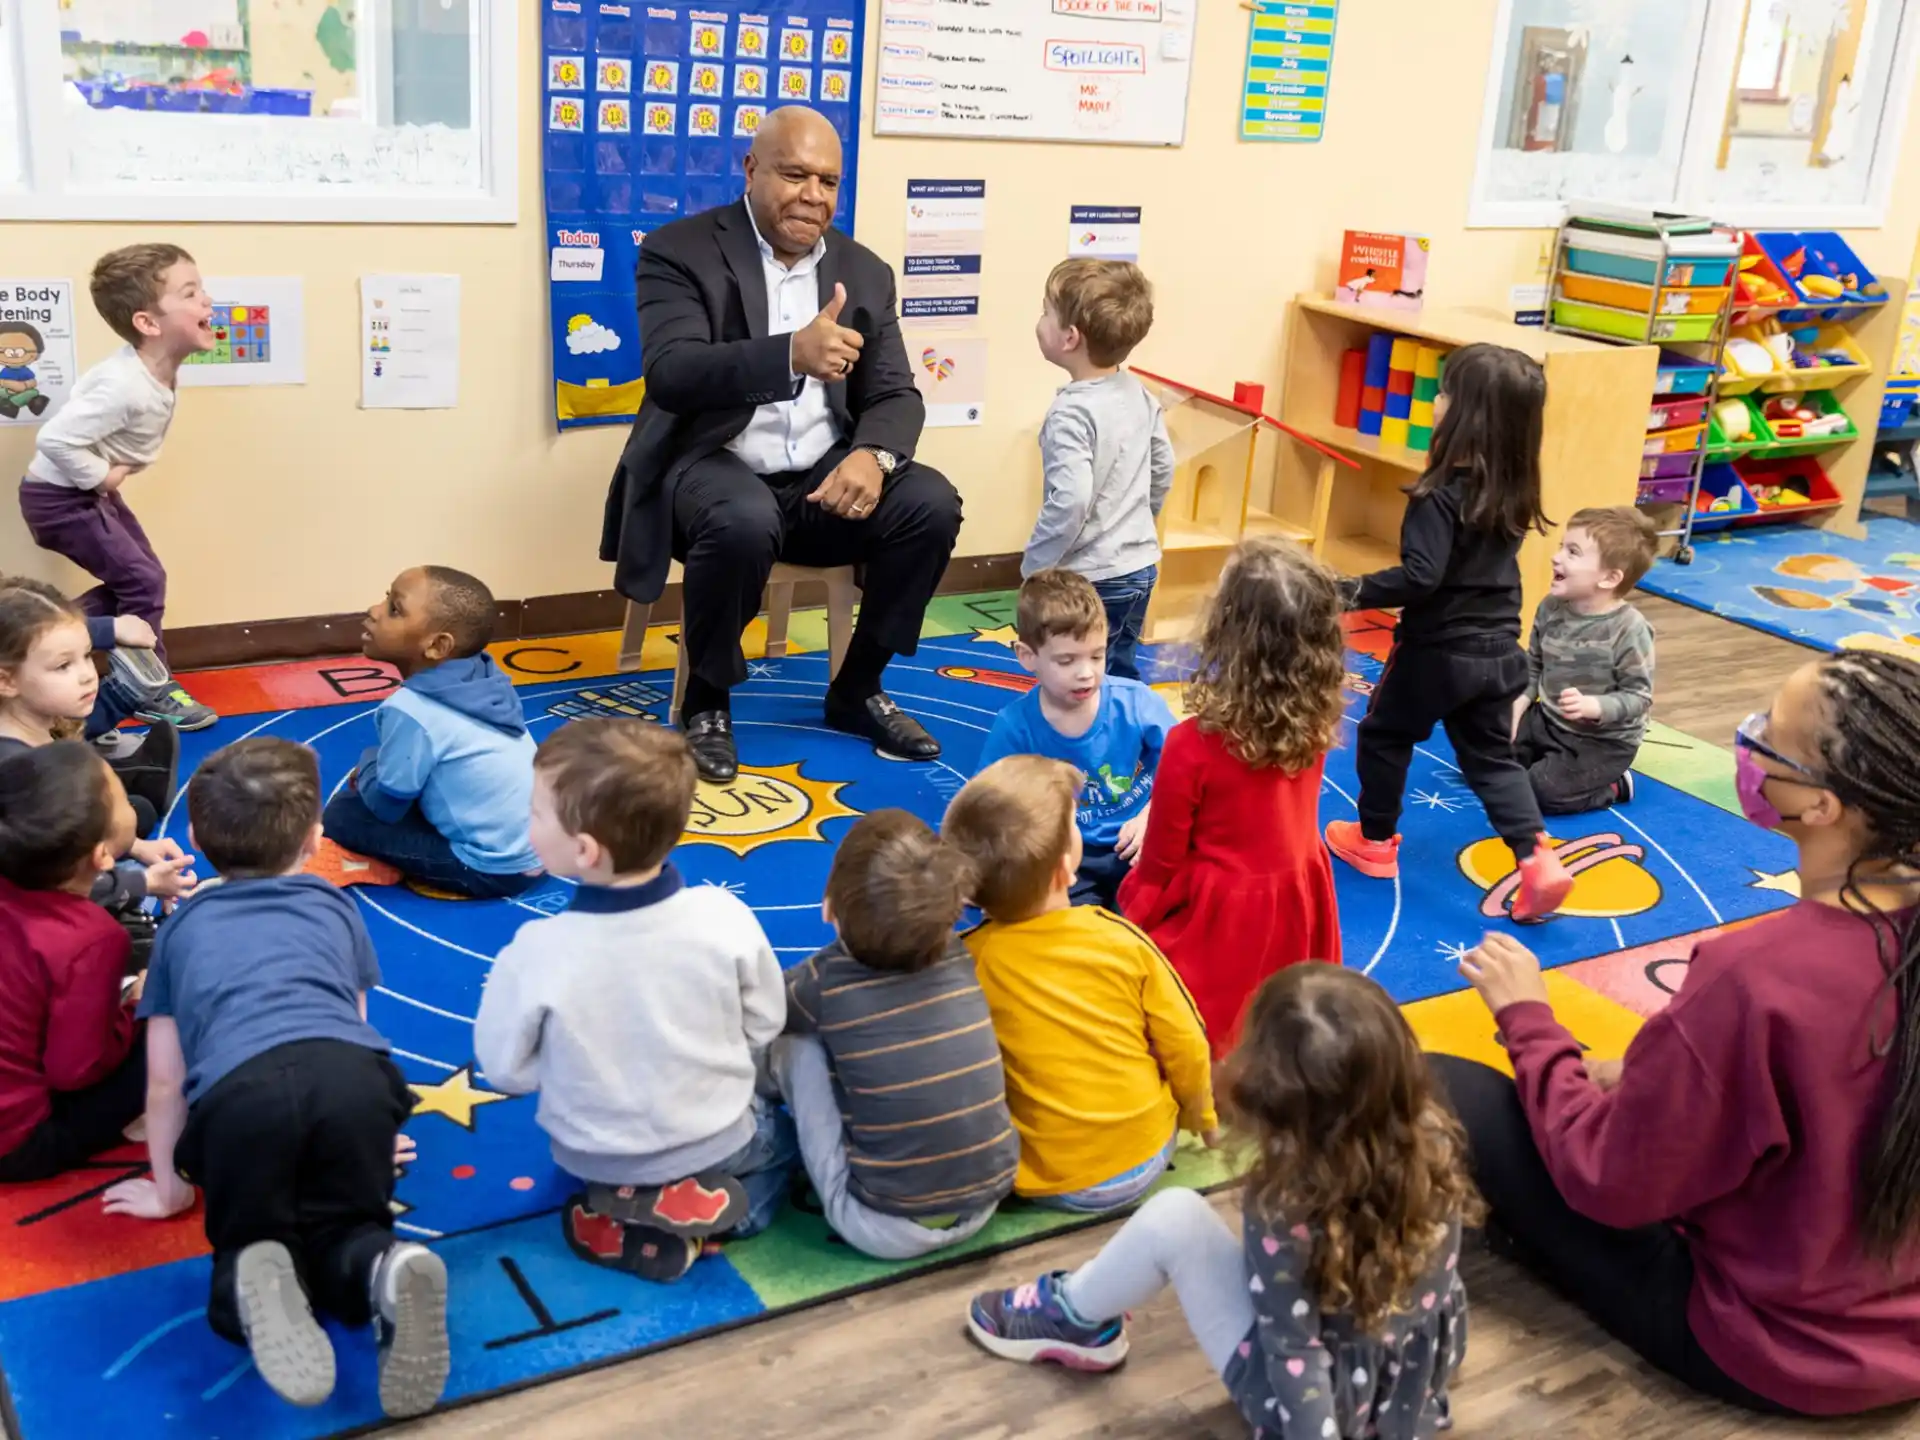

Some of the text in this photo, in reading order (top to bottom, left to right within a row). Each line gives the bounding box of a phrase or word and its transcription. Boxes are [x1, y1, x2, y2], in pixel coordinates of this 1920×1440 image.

[791, 78, 802, 89] 10
[563, 108, 757, 127] 12 13 14 15 16
[558, 231, 599, 247] Today
[558, 260, 595, 270] Thursday
[16, 287, 60, 304] Body
[502, 647, 582, 676] C
[318, 667, 401, 698] B
